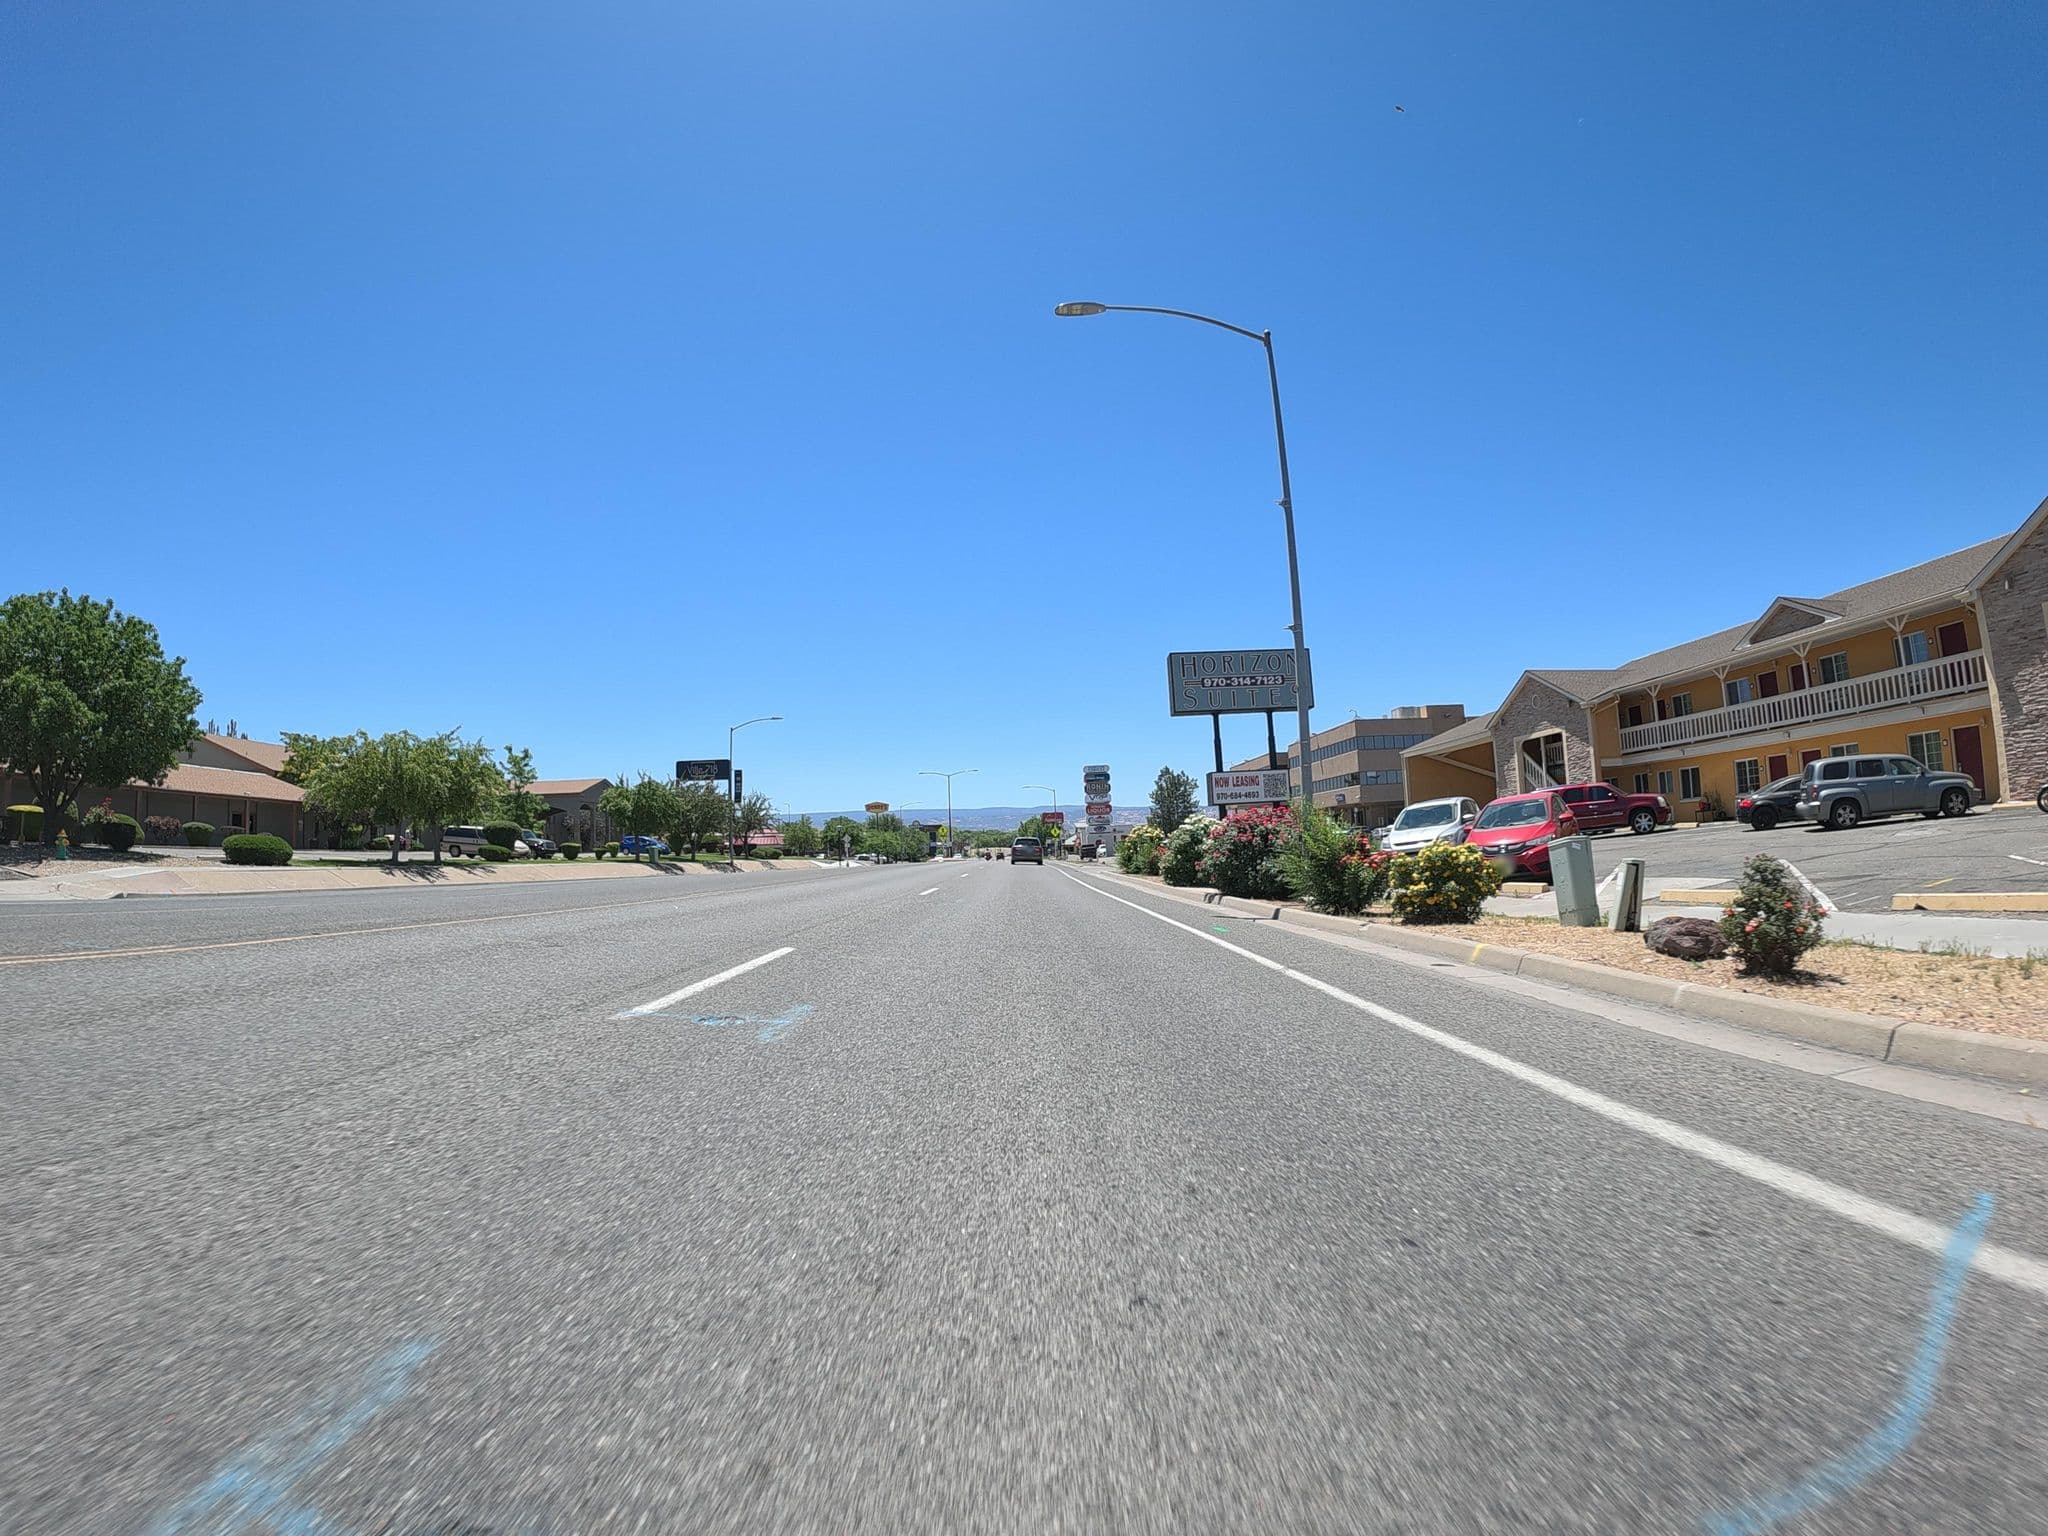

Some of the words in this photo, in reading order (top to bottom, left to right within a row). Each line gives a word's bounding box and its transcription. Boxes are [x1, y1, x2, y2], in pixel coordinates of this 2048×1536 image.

[1203, 675, 1283, 686] 970-314-7123
[1214, 776, 1230, 788] NOW
[1232, 774, 1260, 787] LEASING
